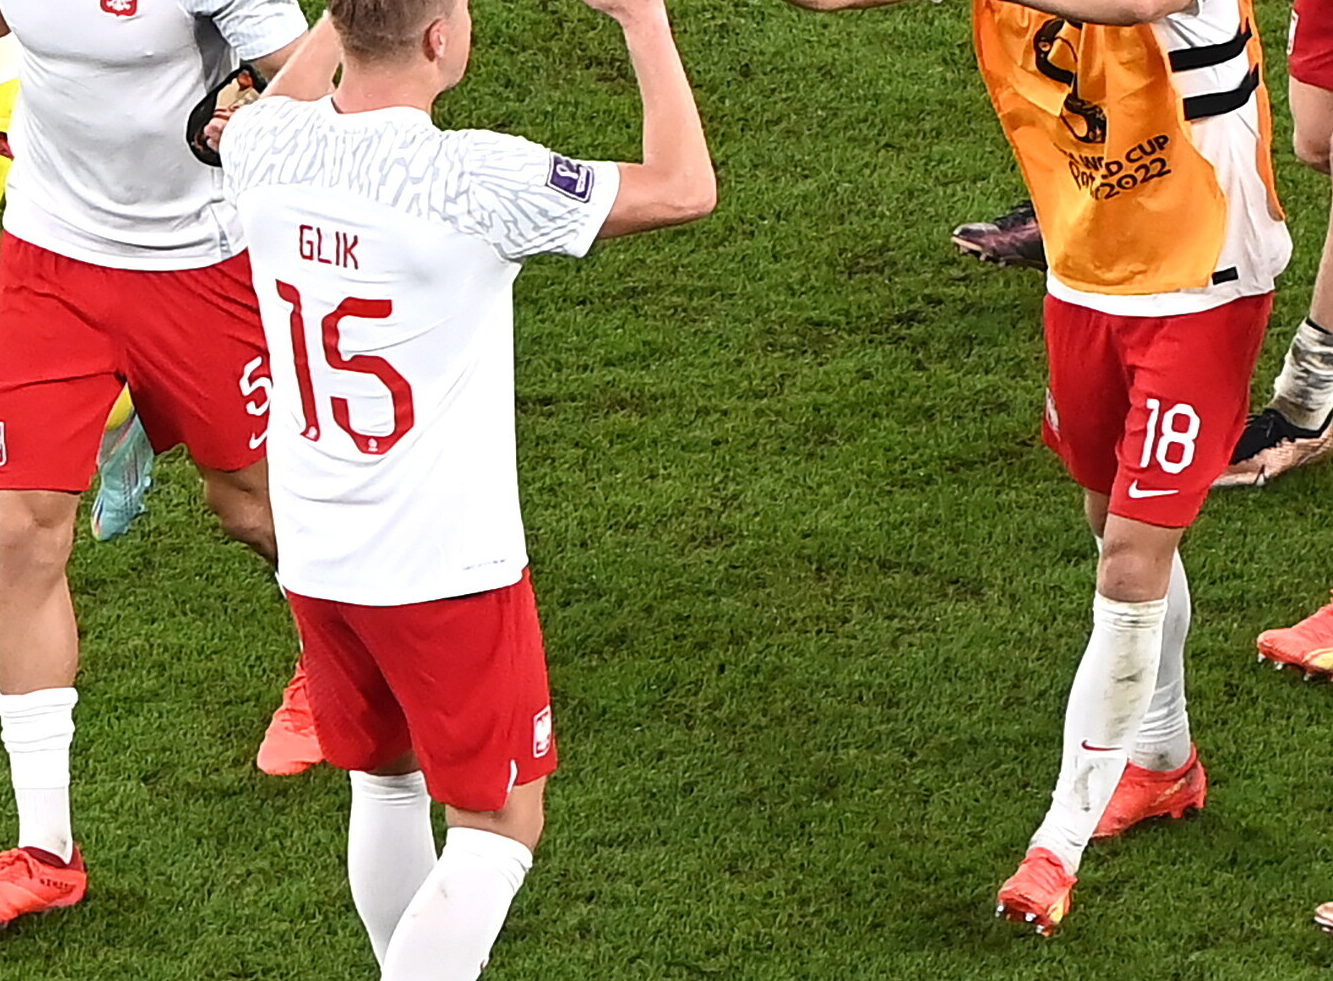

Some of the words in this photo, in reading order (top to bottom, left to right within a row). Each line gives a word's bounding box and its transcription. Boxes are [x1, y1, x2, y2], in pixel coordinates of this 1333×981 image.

[1125, 134, 1170, 163] CUP
[299, 224, 359, 270] GLIK
[239, 355, 273, 416] 5
[275, 279, 415, 455] 15
[1139, 398, 1201, 474] 18
